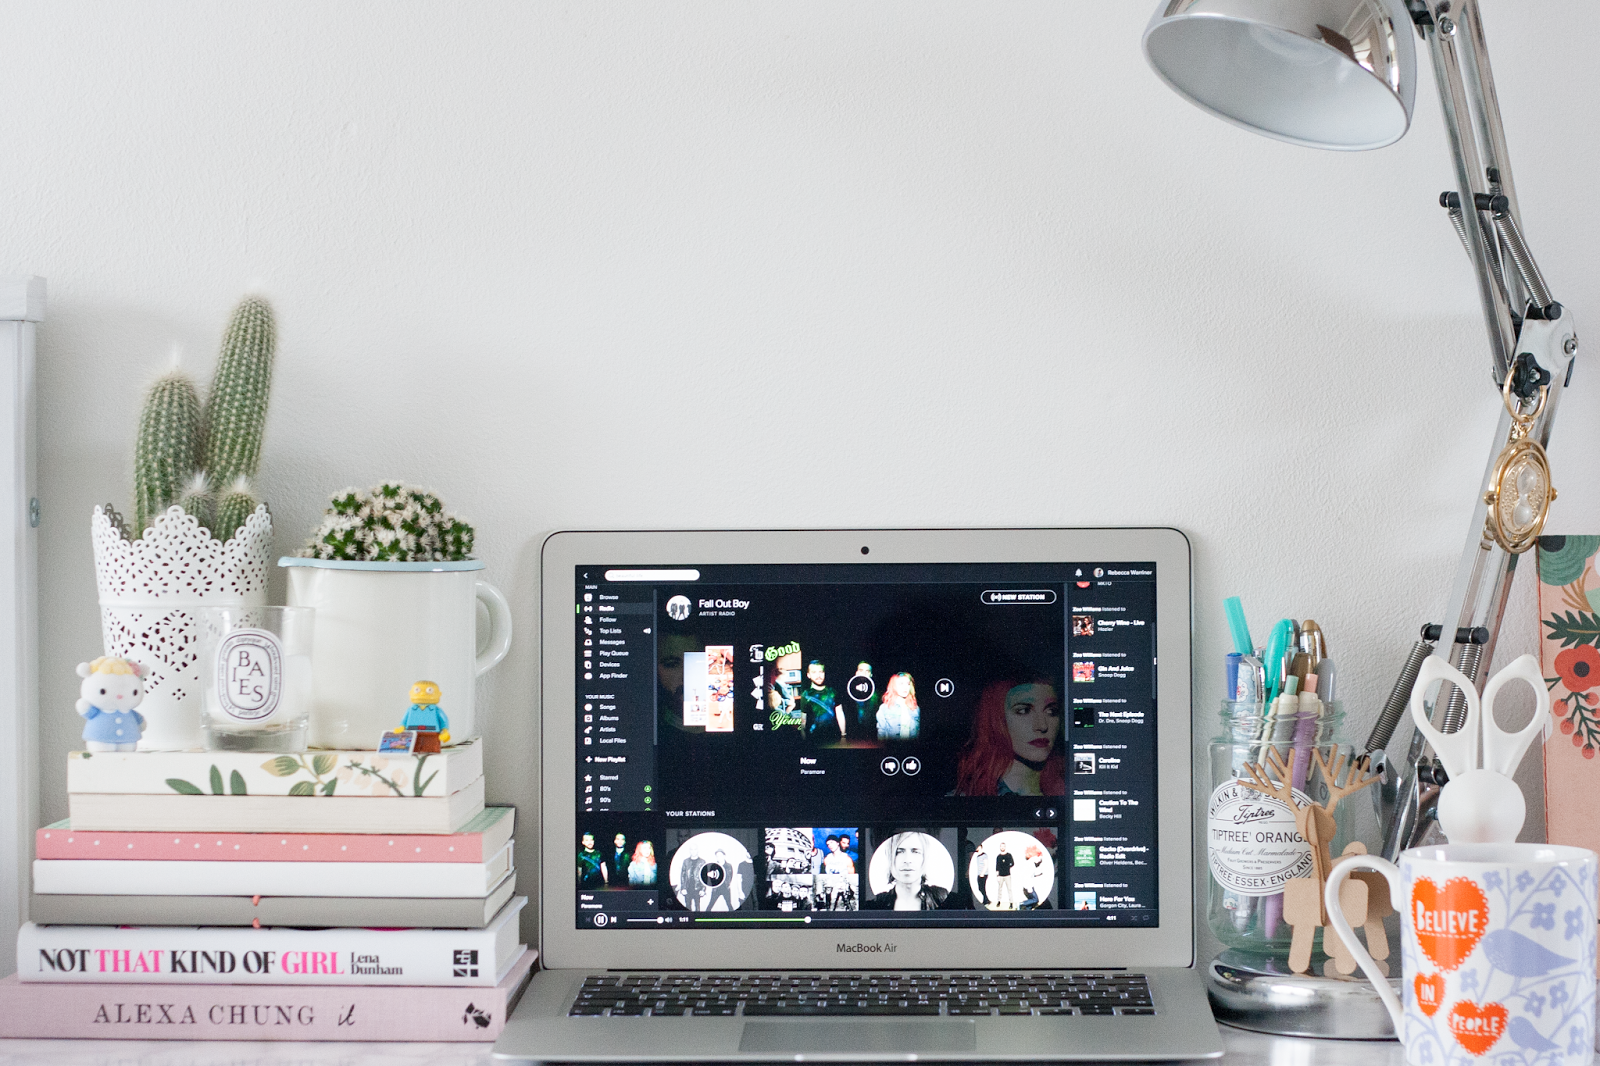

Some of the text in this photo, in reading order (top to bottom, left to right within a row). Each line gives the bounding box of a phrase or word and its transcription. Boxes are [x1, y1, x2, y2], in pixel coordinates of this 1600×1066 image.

[699, 599, 750, 609] Fall Out Boy
[765, 641, 800, 661] Good
[1233, 804, 1275, 825] Tiptree
[1256, 832, 1308, 843] ORANG
[1254, 847, 1297, 856] Marmalade
[1211, 852, 1313, 887] TIPTREE ESSEX ENGLAND
[1416, 900, 1479, 933] BELIEVE
[836, 943, 898, 953] MacBook Air
[39, 949, 345, 975] NOT THAT KIND OF GIRL
[351, 952, 379, 964] Lena
[351, 964, 403, 975] Dunham
[1420, 983, 1435, 1002] IN
[93, 1004, 198, 1023] ALEXA
[209, 1005, 315, 1026] CHUNG
[1452, 1013, 1500, 1033] PEOPLE
